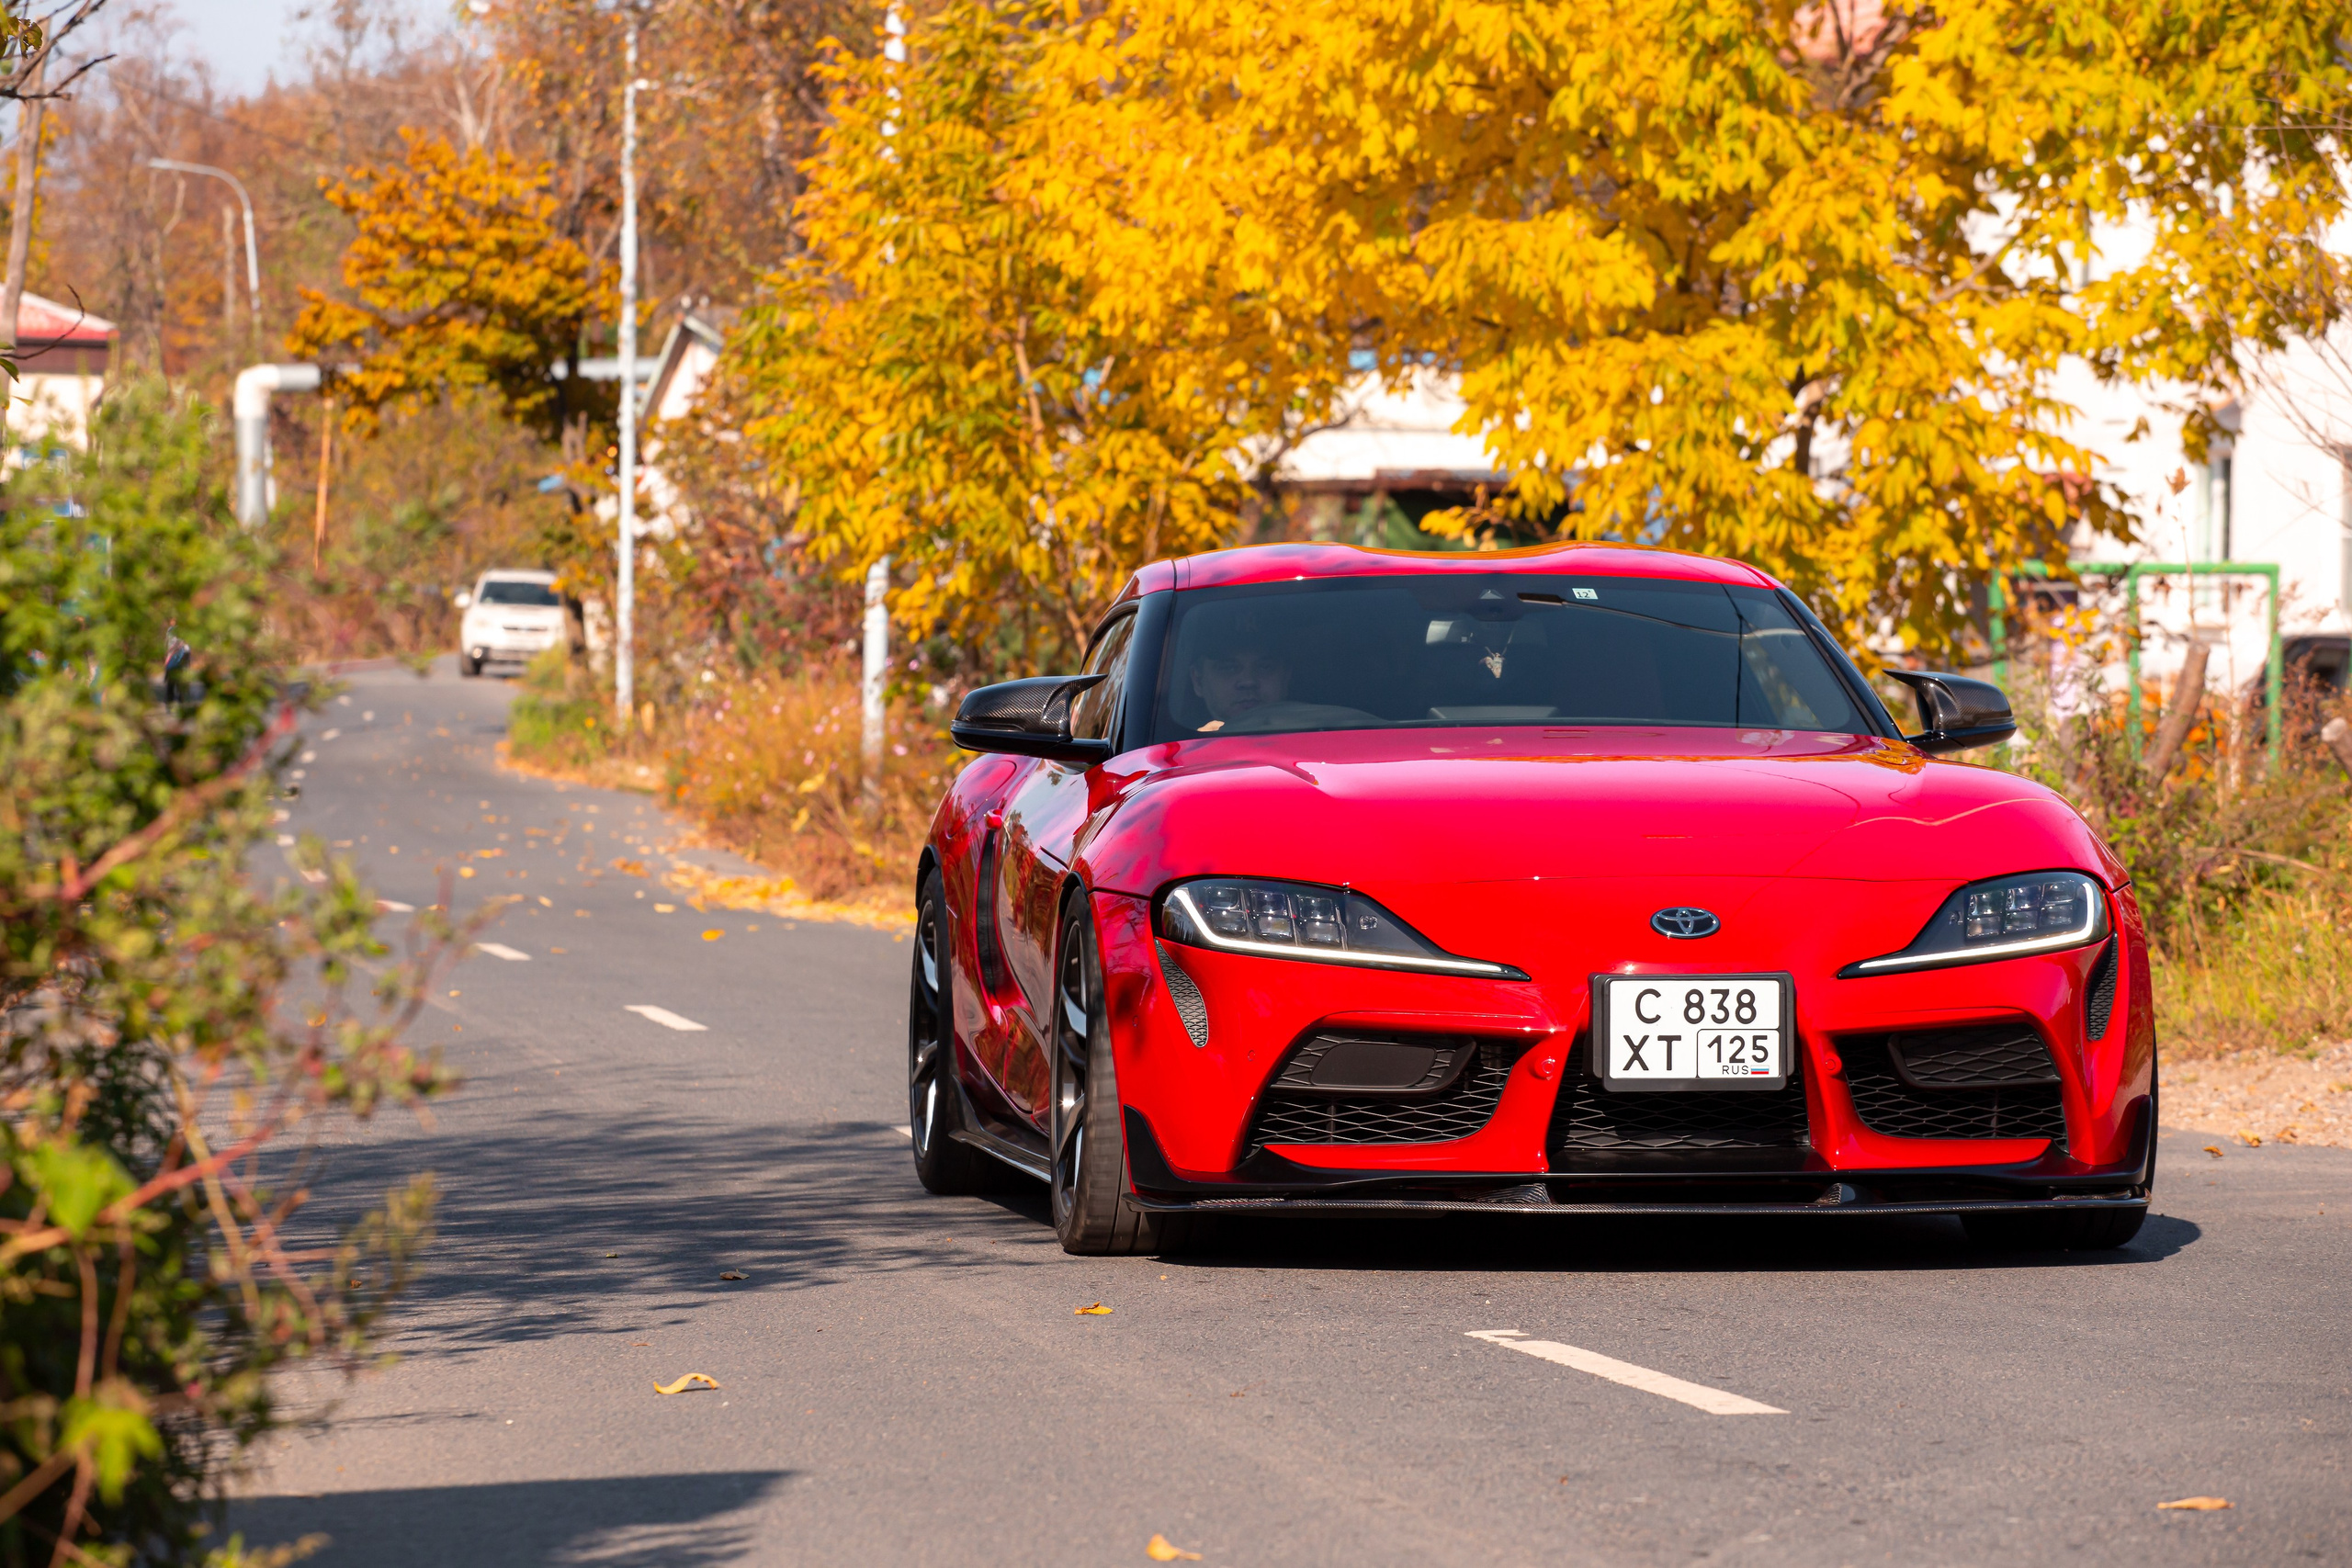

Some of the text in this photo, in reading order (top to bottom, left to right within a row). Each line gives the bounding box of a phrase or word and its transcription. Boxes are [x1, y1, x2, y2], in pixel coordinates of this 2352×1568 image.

[1683, 988, 1757, 1024] 838
[1707, 1035, 1769, 1064] 125
[1722, 1065, 1749, 1075] RUS
